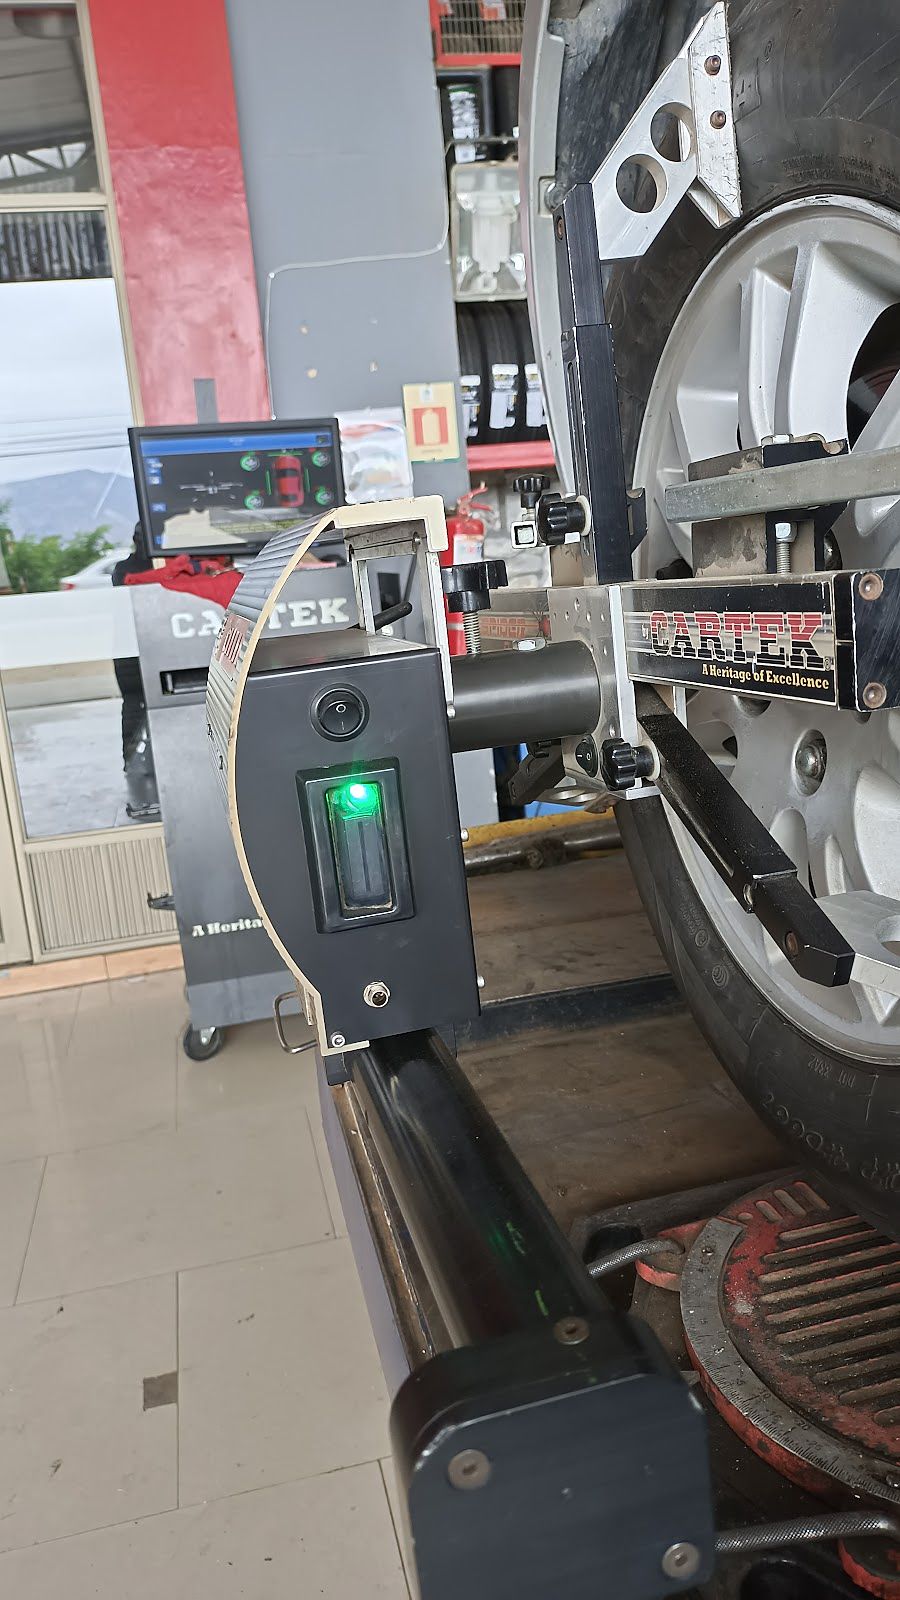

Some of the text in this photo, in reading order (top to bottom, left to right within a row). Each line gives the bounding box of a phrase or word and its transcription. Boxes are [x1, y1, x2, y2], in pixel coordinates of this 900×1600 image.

[171, 597, 350, 639] CATEK
[650, 611, 825, 669] CARTEK
[702, 664, 829, 690] A Heritage of Excellence
[192, 918, 263, 937] A Herita
